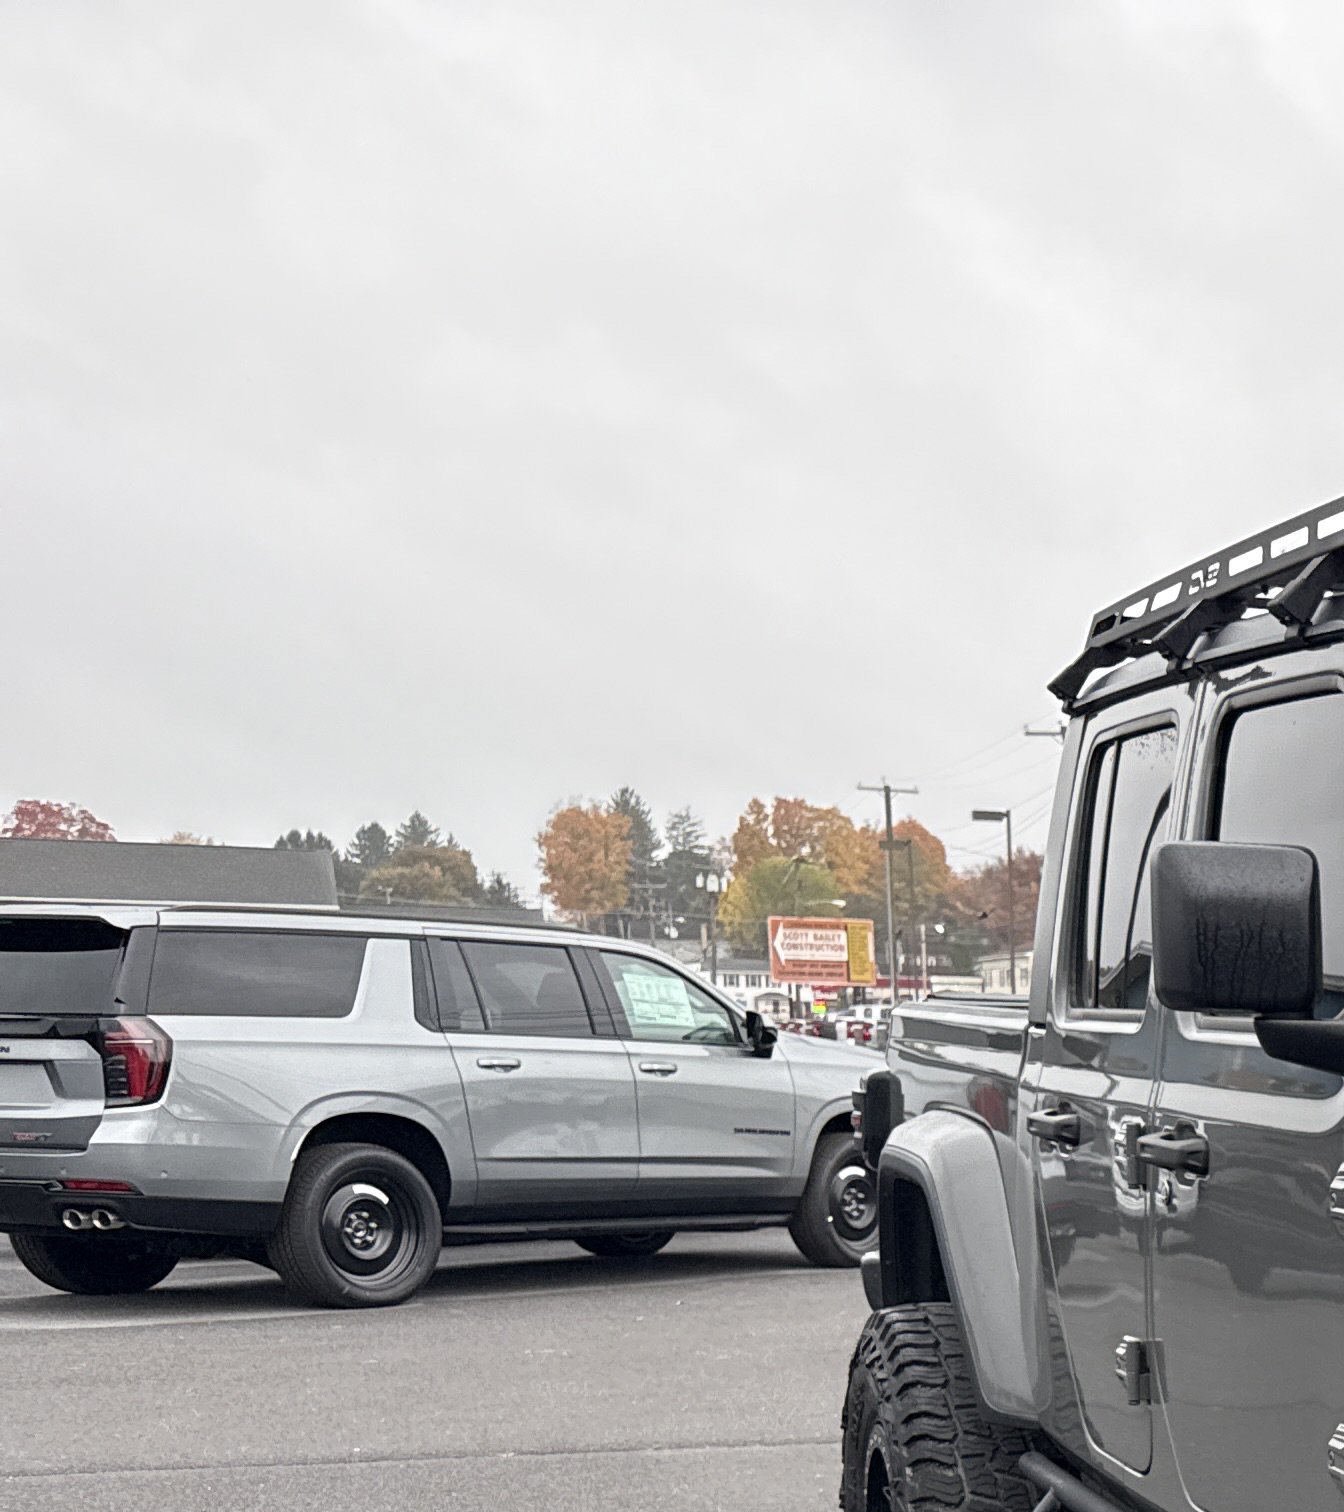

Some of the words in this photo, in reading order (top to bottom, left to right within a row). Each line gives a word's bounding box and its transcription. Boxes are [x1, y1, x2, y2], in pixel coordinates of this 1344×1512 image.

[782, 931, 809, 941] SCOTT
[813, 933, 842, 942] BAILEY
[781, 942, 845, 952] CONSTRUCTION
